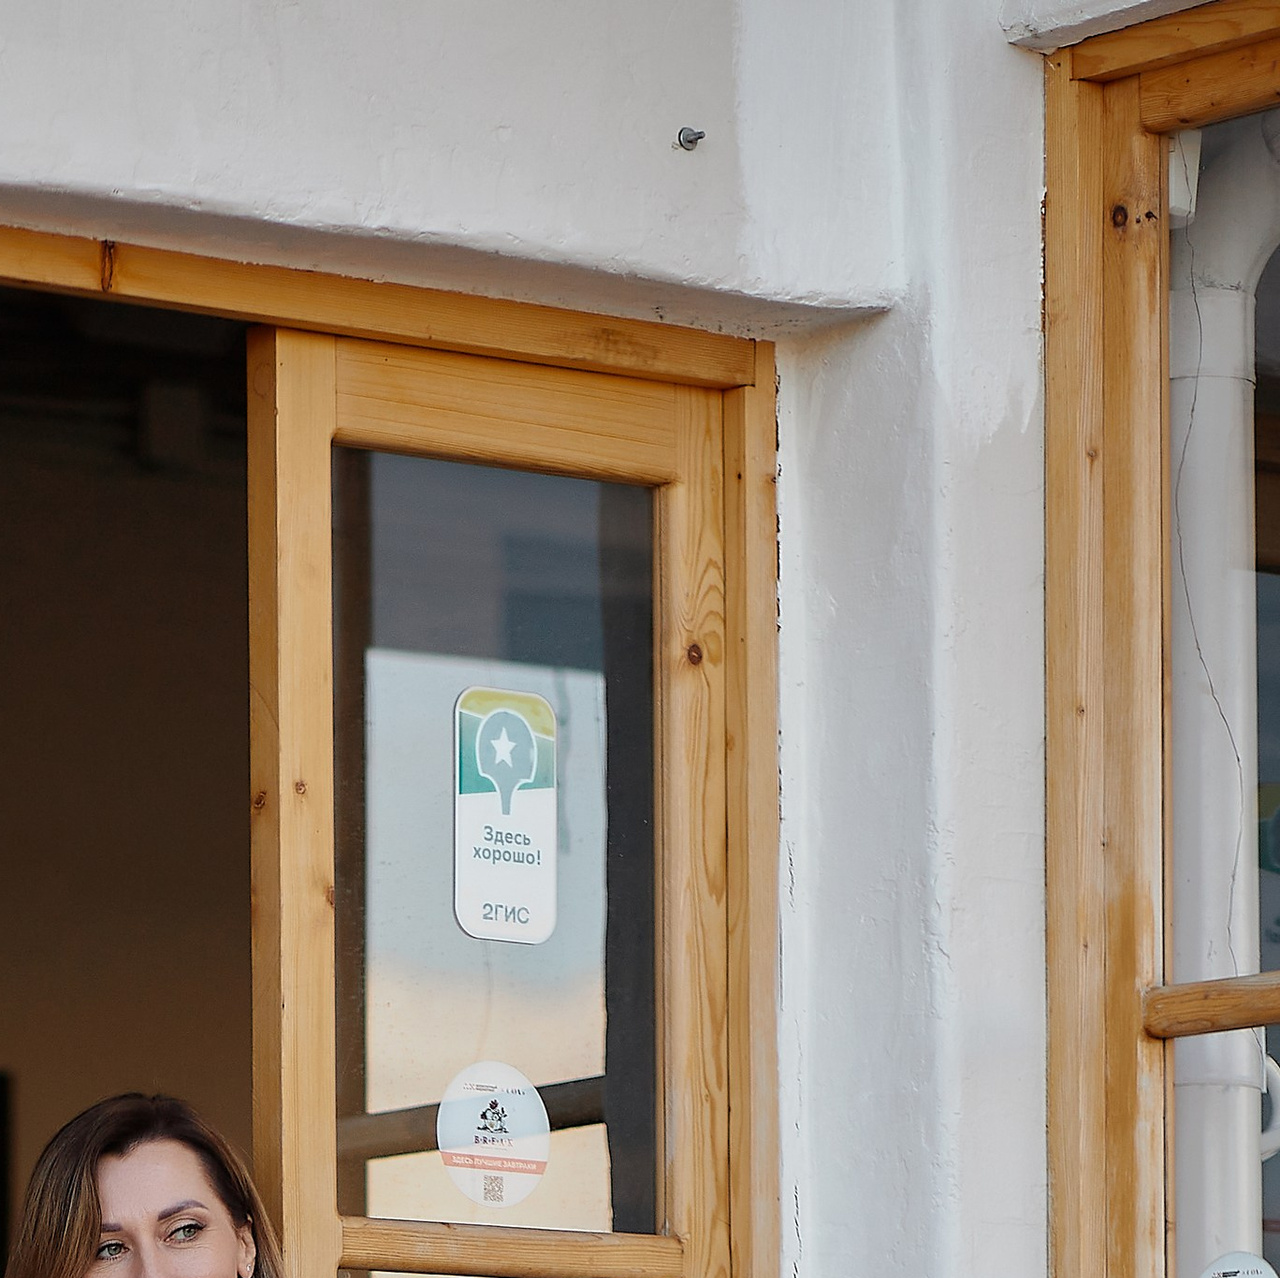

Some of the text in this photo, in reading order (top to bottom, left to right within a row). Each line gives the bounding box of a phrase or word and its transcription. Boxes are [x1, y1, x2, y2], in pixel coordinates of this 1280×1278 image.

[483, 825, 531, 846] Здесь
[473, 846, 541, 866] хорошо!
[482, 902, 530, 924] 2ГИС
